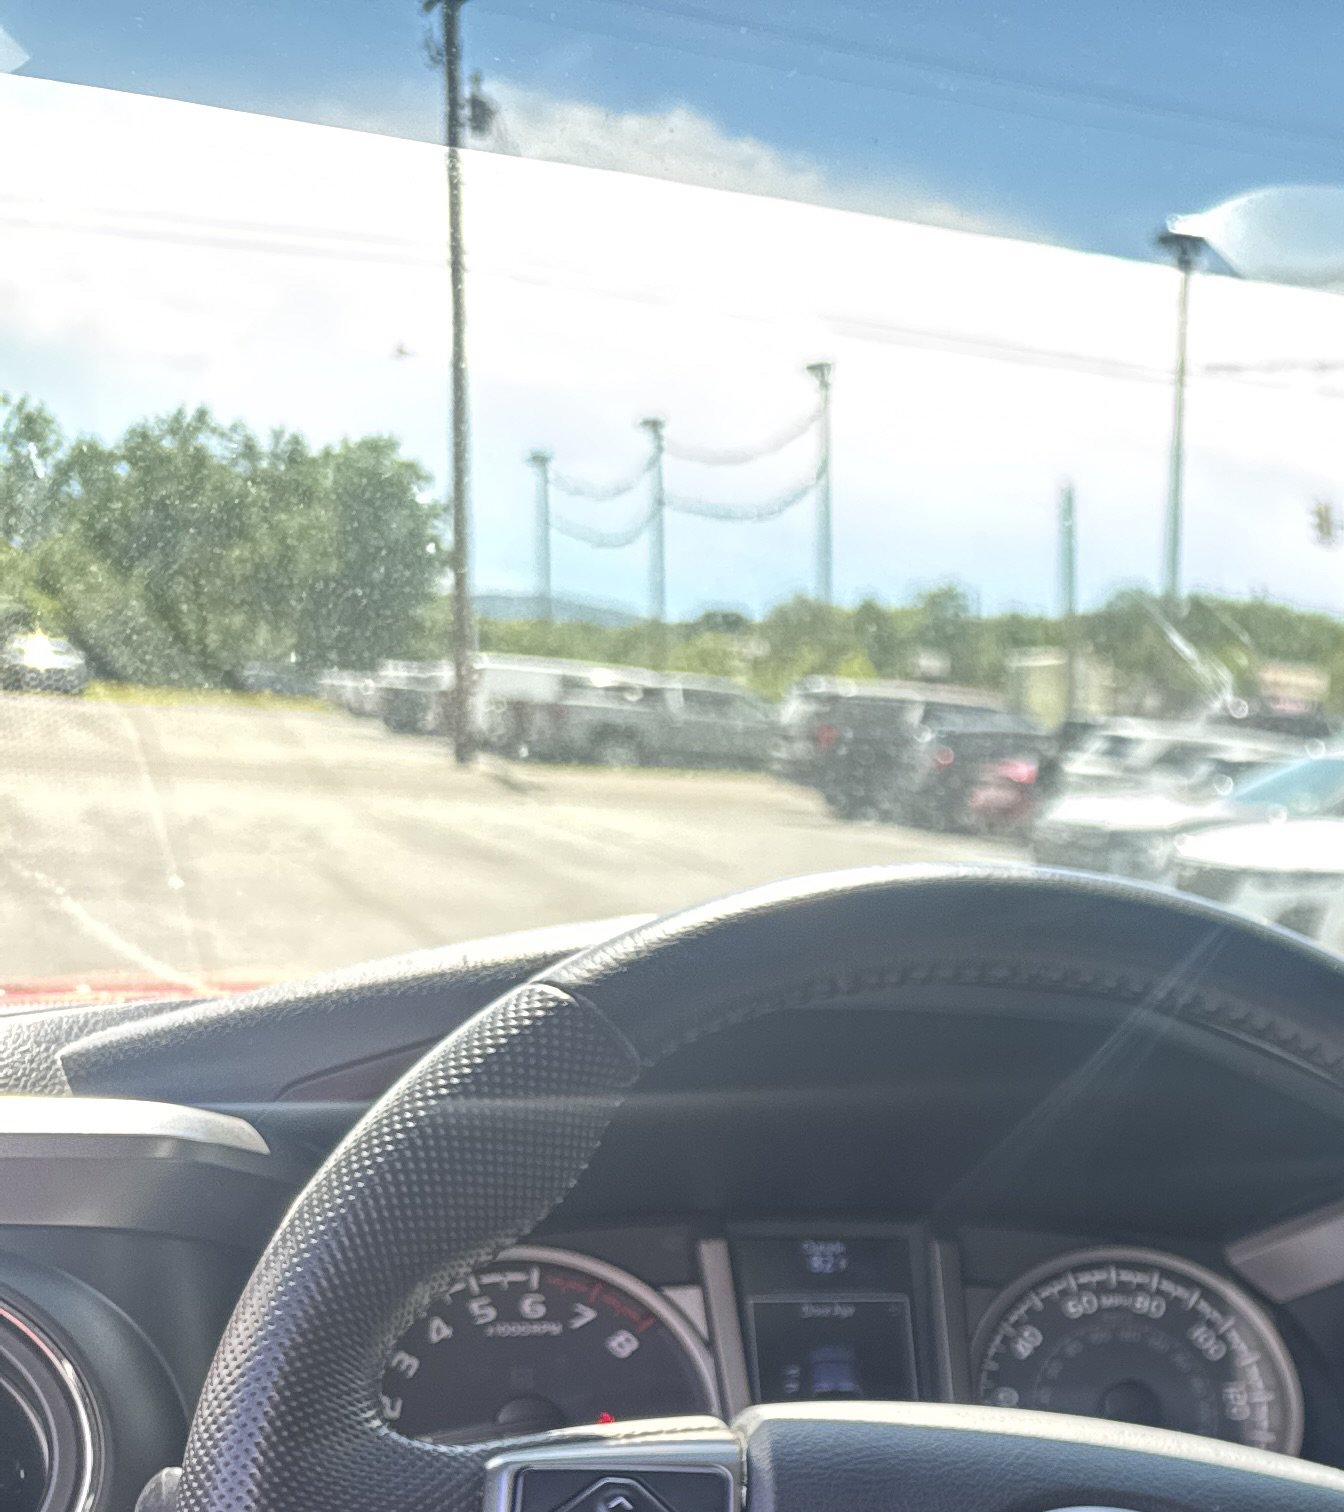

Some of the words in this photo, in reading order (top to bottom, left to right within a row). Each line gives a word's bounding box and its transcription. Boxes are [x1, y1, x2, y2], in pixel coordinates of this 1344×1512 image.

[467, 1295, 498, 1325] 5
[517, 1292, 549, 1321] 6
[567, 1303, 599, 1331] 7
[427, 1315, 455, 1345] 4
[604, 1329, 641, 1359] 8
[390, 1350, 421, 1380] 3
